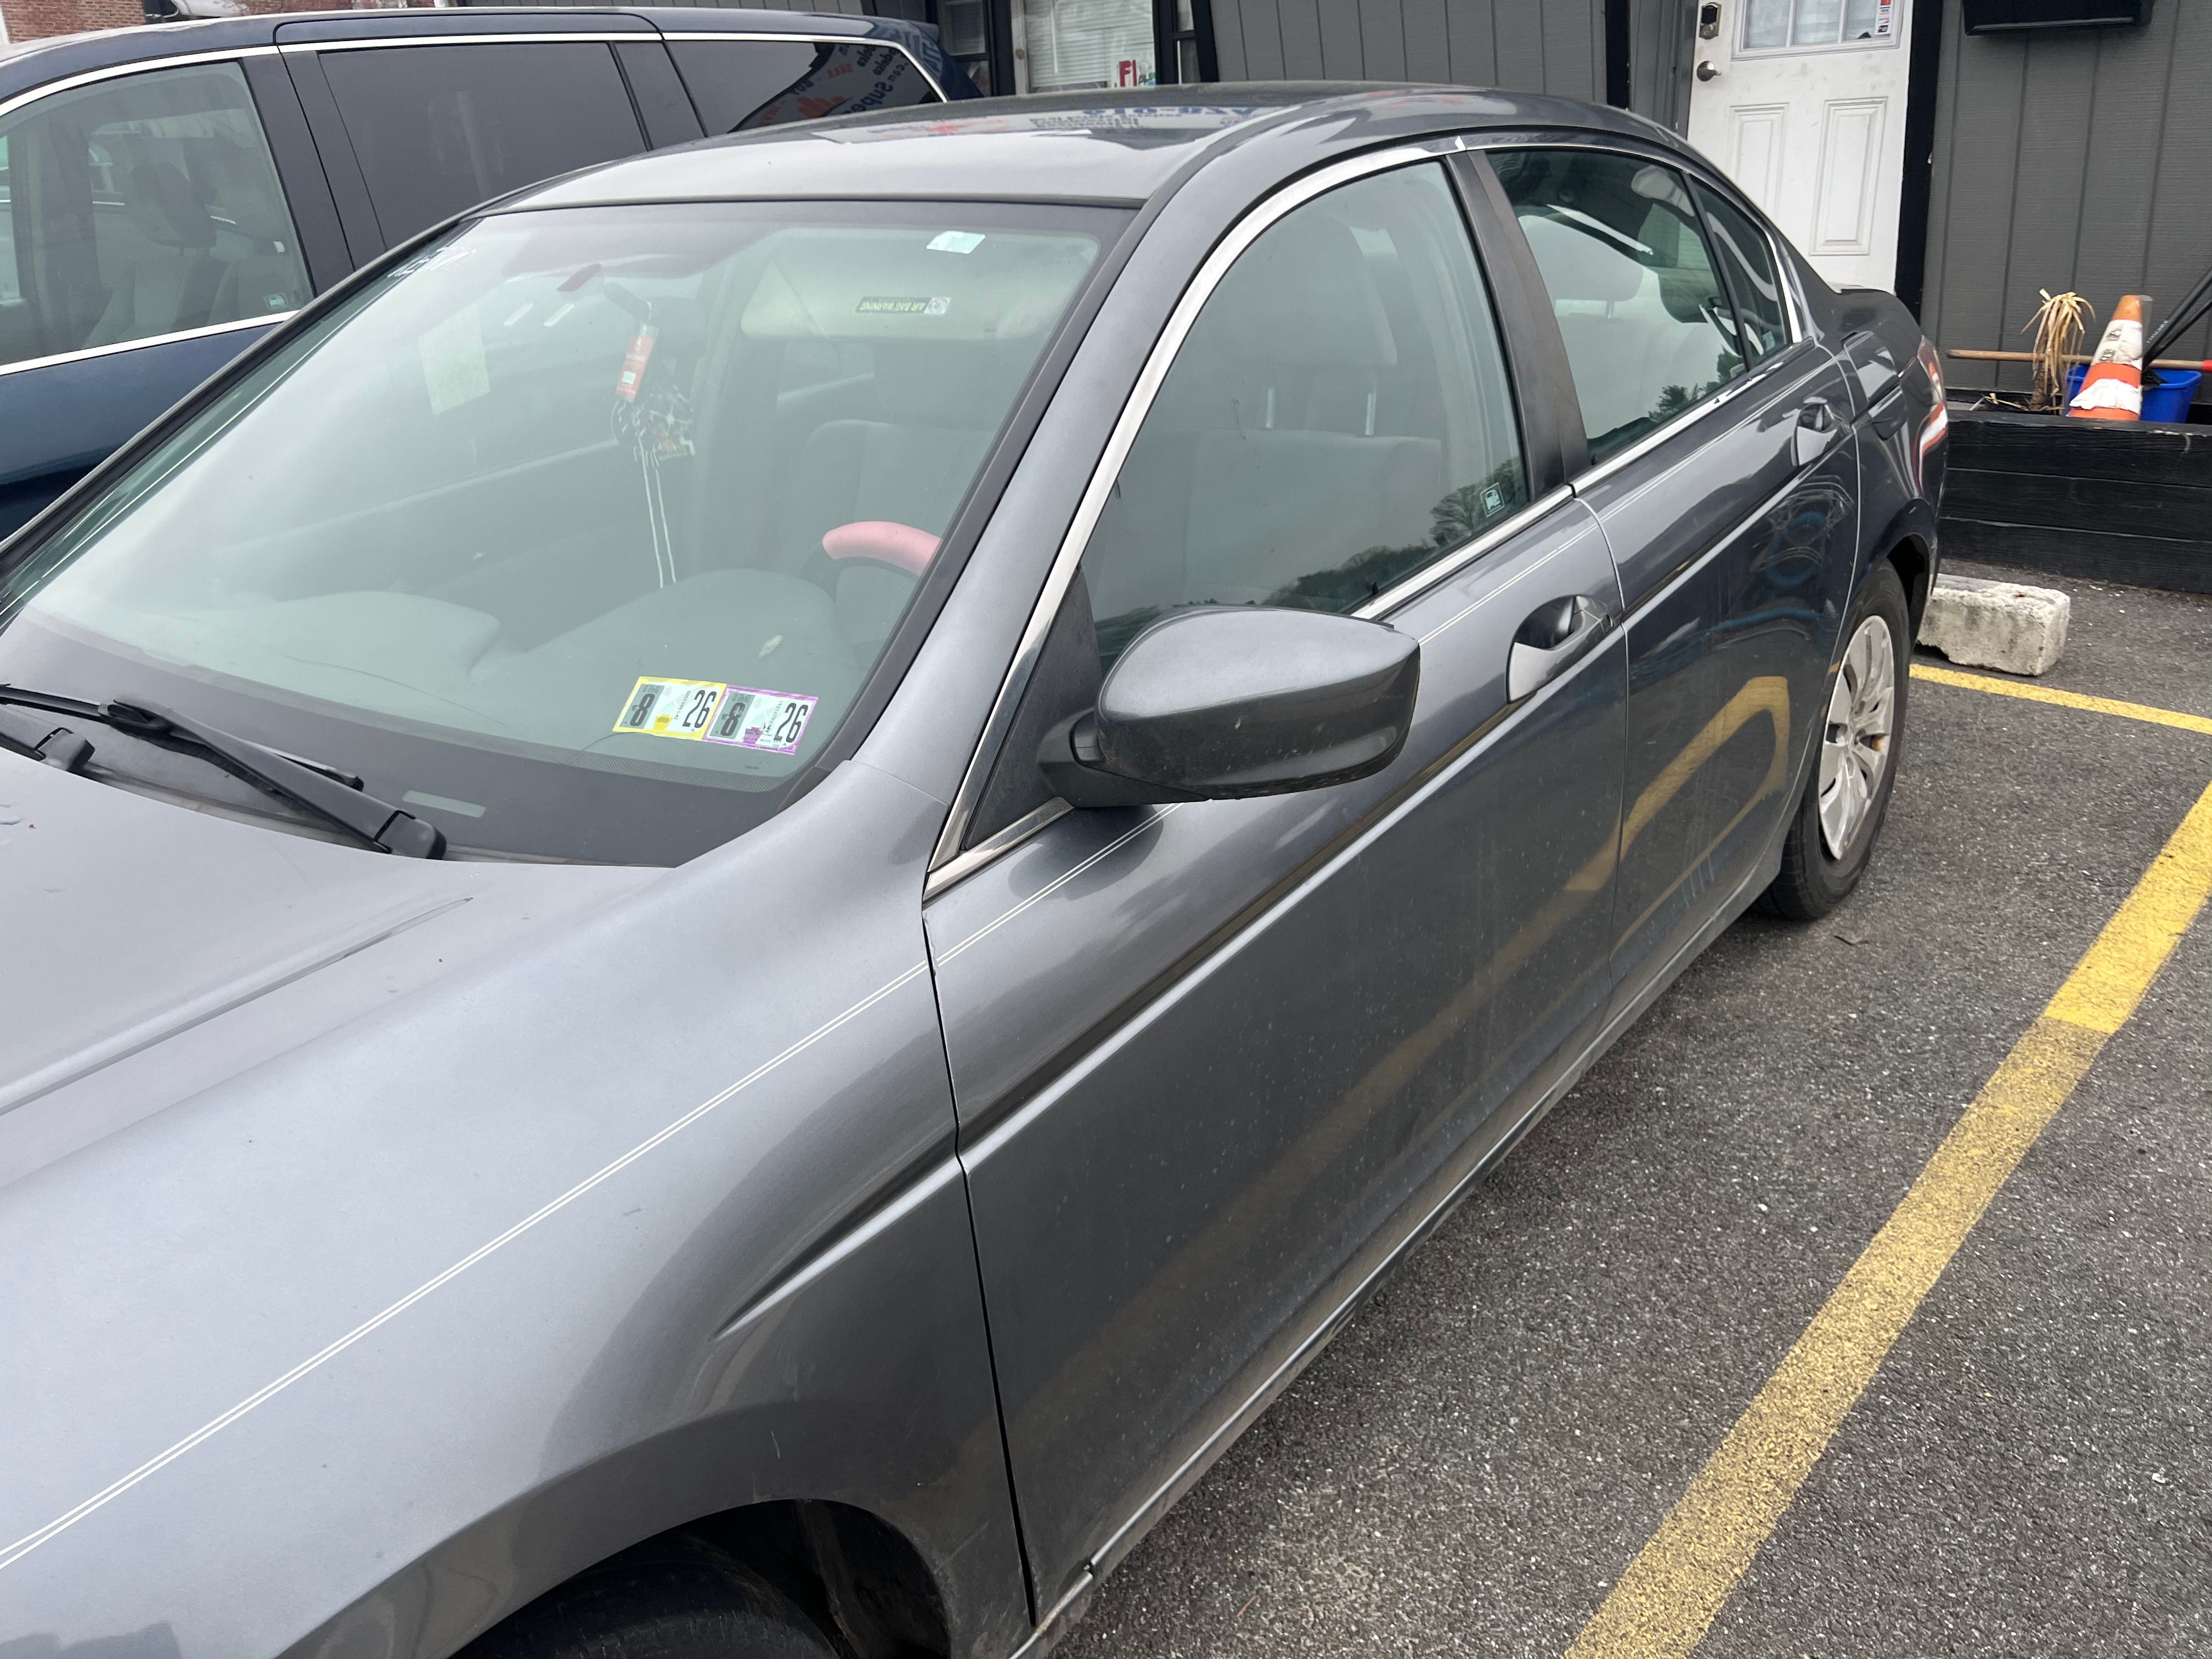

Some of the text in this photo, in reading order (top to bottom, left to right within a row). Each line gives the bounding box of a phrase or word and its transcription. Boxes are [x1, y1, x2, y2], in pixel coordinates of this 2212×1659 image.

[630, 693, 655, 726] 8
[682, 690, 717, 728] 26
[720, 702, 746, 736] 8
[774, 703, 808, 743] 26
